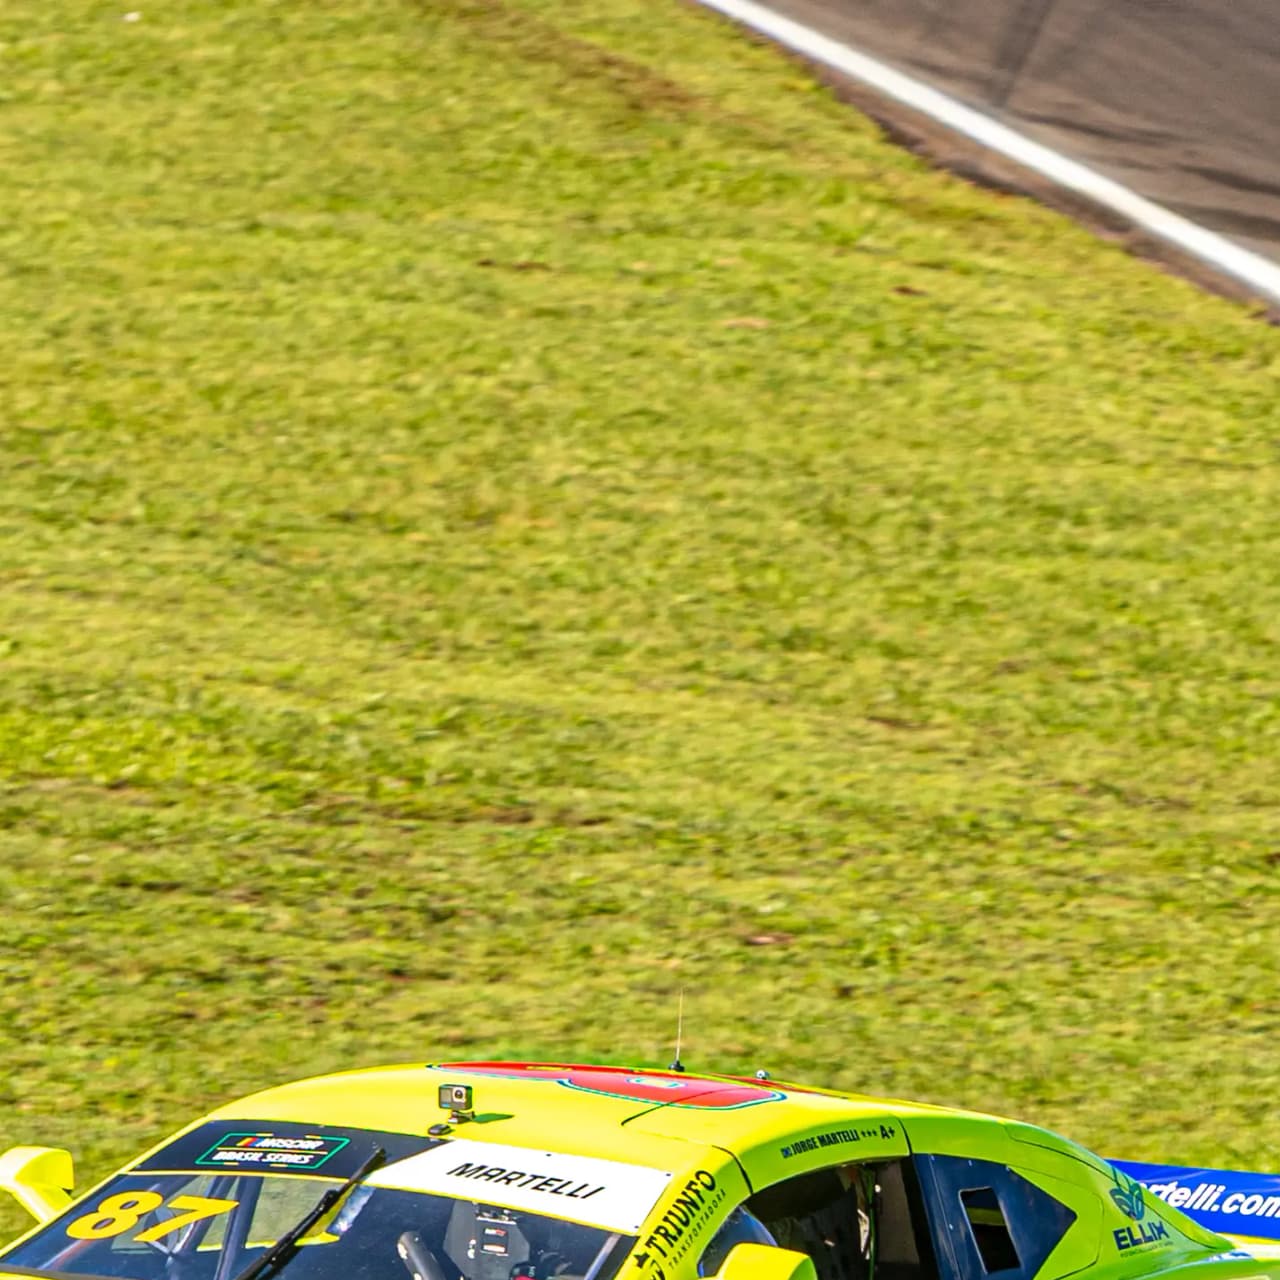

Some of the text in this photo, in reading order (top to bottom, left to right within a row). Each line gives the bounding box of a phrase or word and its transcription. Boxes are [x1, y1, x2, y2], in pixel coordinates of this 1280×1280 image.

[791, 1136, 819, 1156] JORGE
[817, 1128, 860, 1150] MARTELLI
[446, 1162, 605, 1200] MARTELLI
[66, 1191, 240, 1243] 87
[646, 1169, 717, 1259] TRIUNFO
[1113, 1220, 1171, 1251] ELLIX
